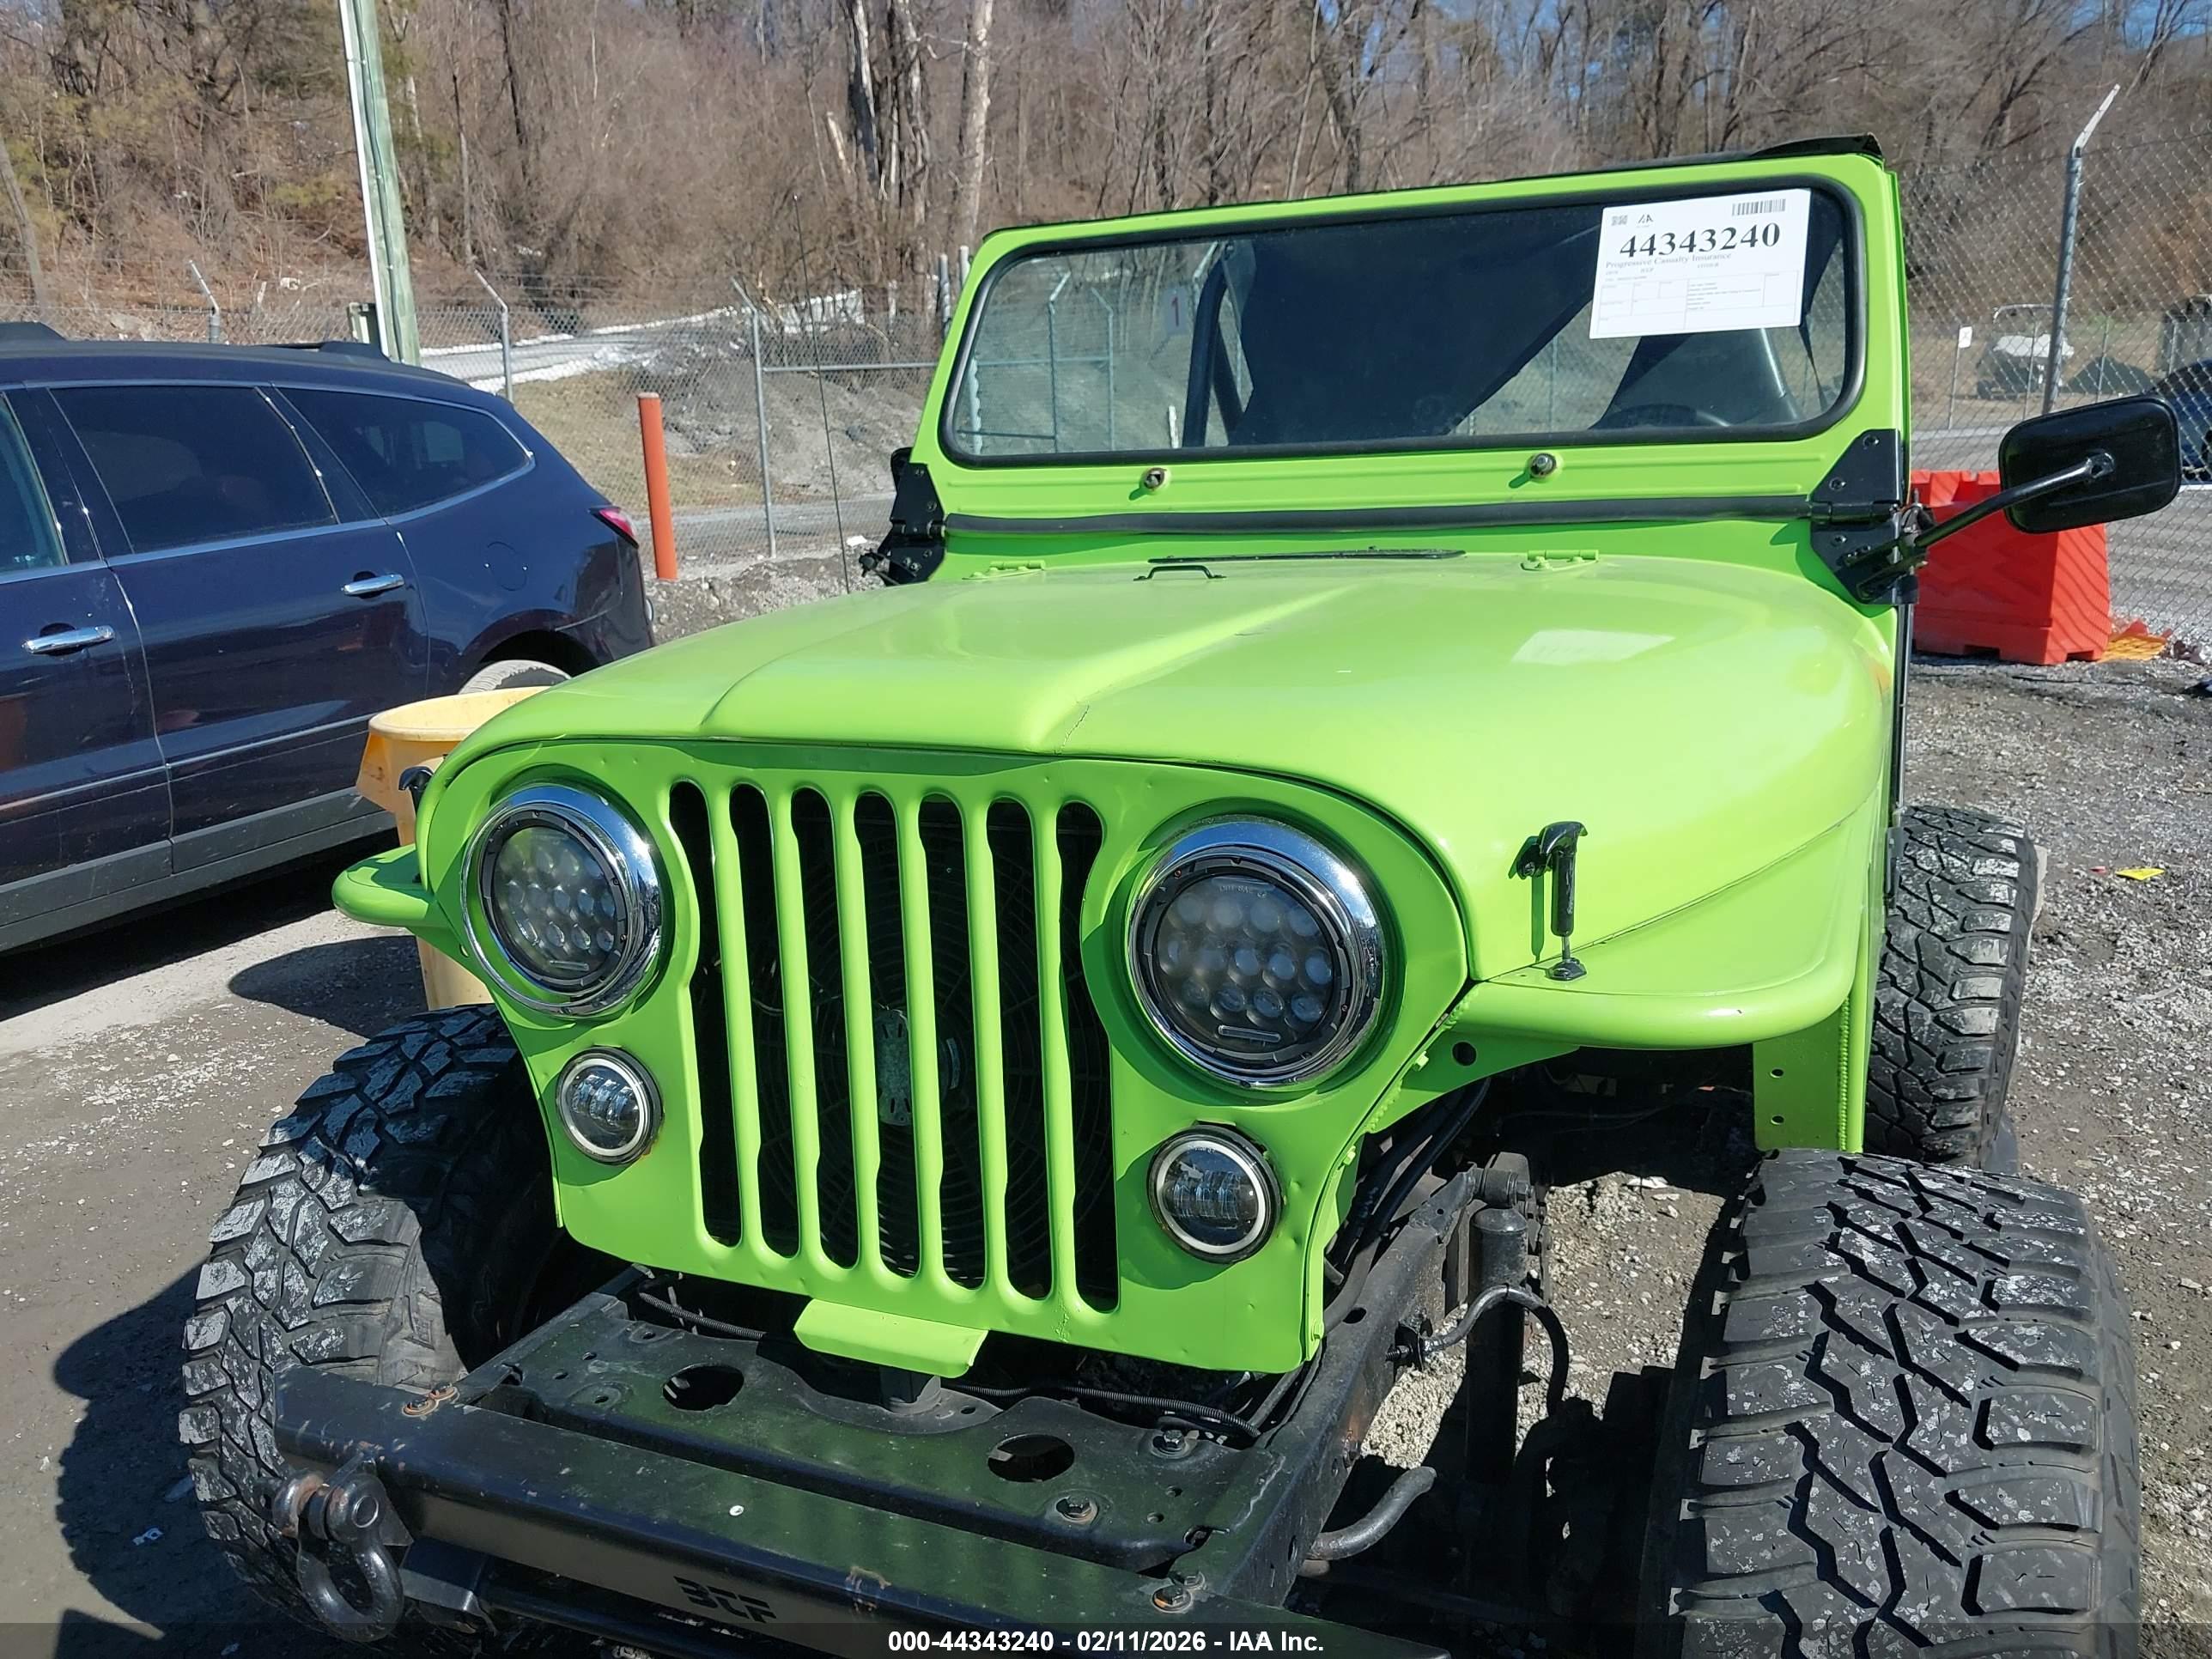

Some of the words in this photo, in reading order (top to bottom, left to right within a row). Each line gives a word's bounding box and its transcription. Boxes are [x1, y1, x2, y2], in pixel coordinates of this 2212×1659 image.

[1620, 222, 1780, 258] 44343240
[1606, 258, 1651, 270] Progressive
[1654, 255, 1689, 265] Casualty
[1692, 252, 1732, 263] Insurance
[1170, 295, 1180, 327] 1
